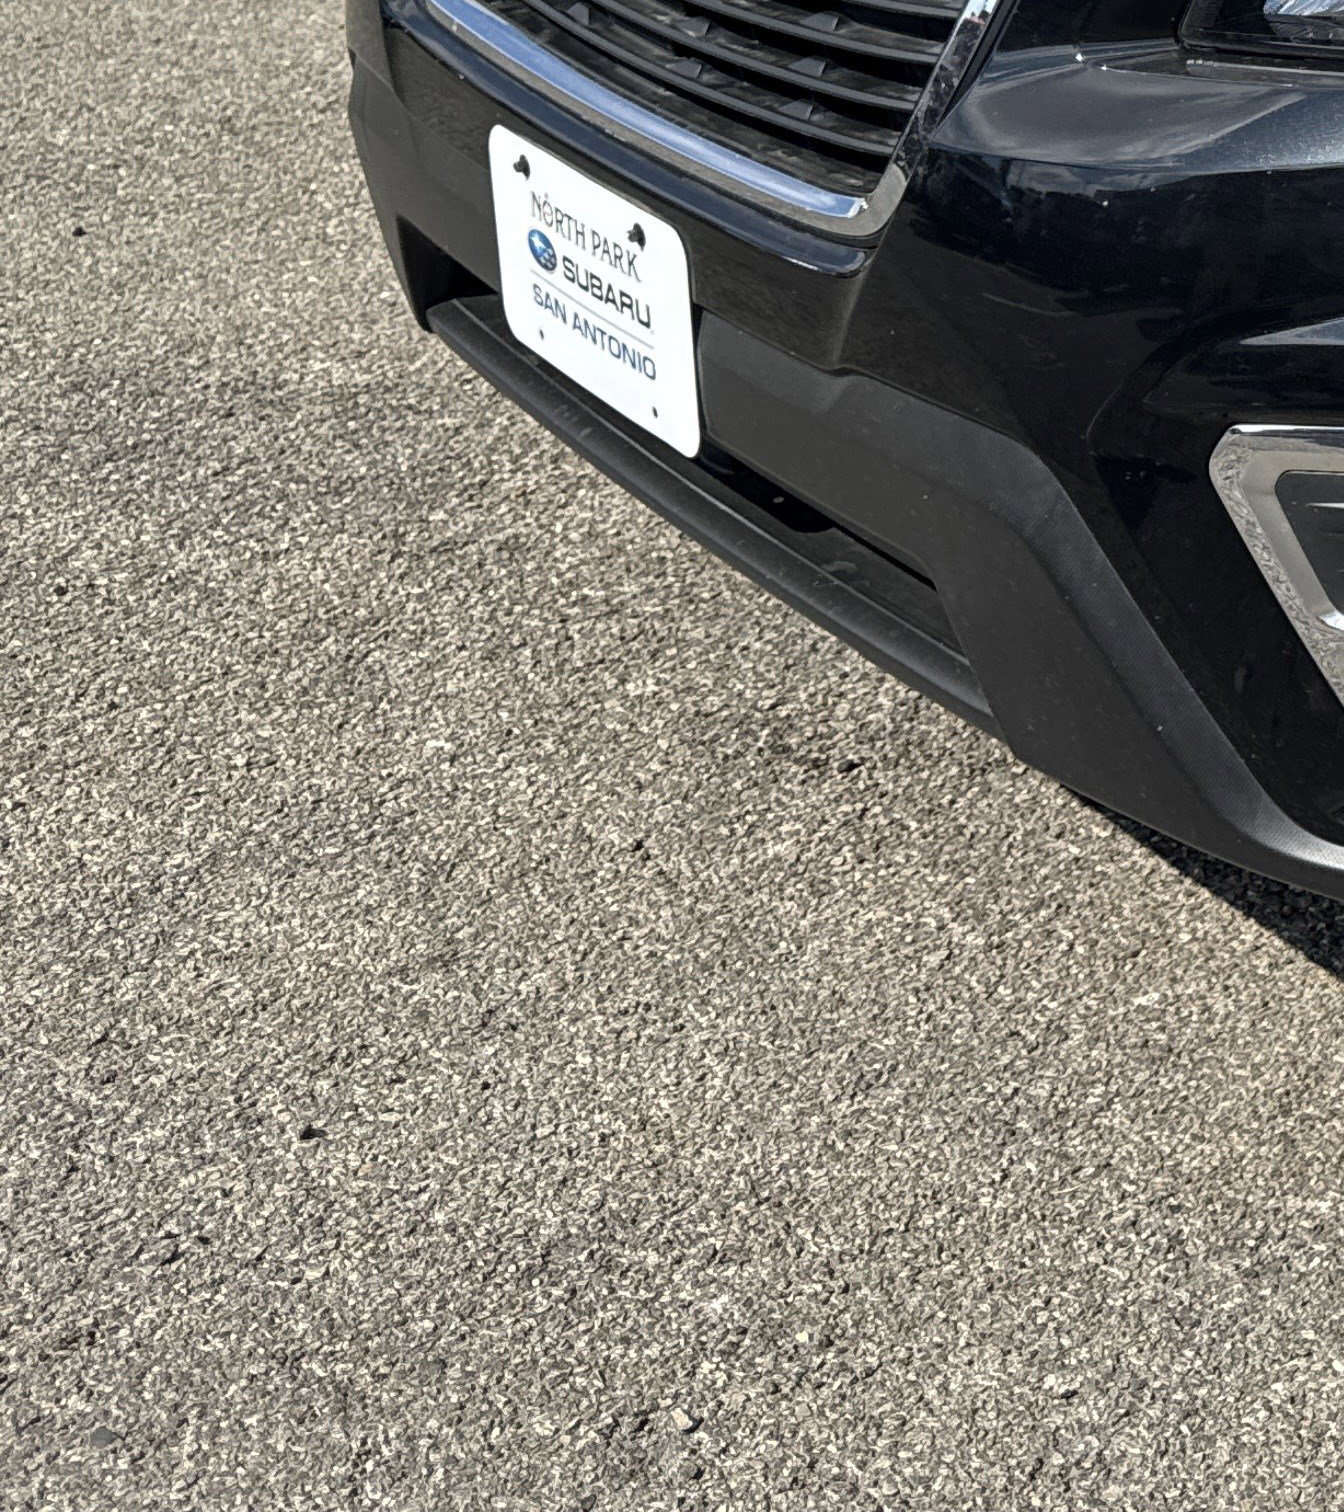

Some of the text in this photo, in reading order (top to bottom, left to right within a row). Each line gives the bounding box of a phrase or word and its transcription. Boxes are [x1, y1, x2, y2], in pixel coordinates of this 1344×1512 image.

[530, 190, 642, 283] NORTH PARK
[532, 283, 657, 381] SAN ANTONIO
[562, 255, 651, 329] SUBARU
